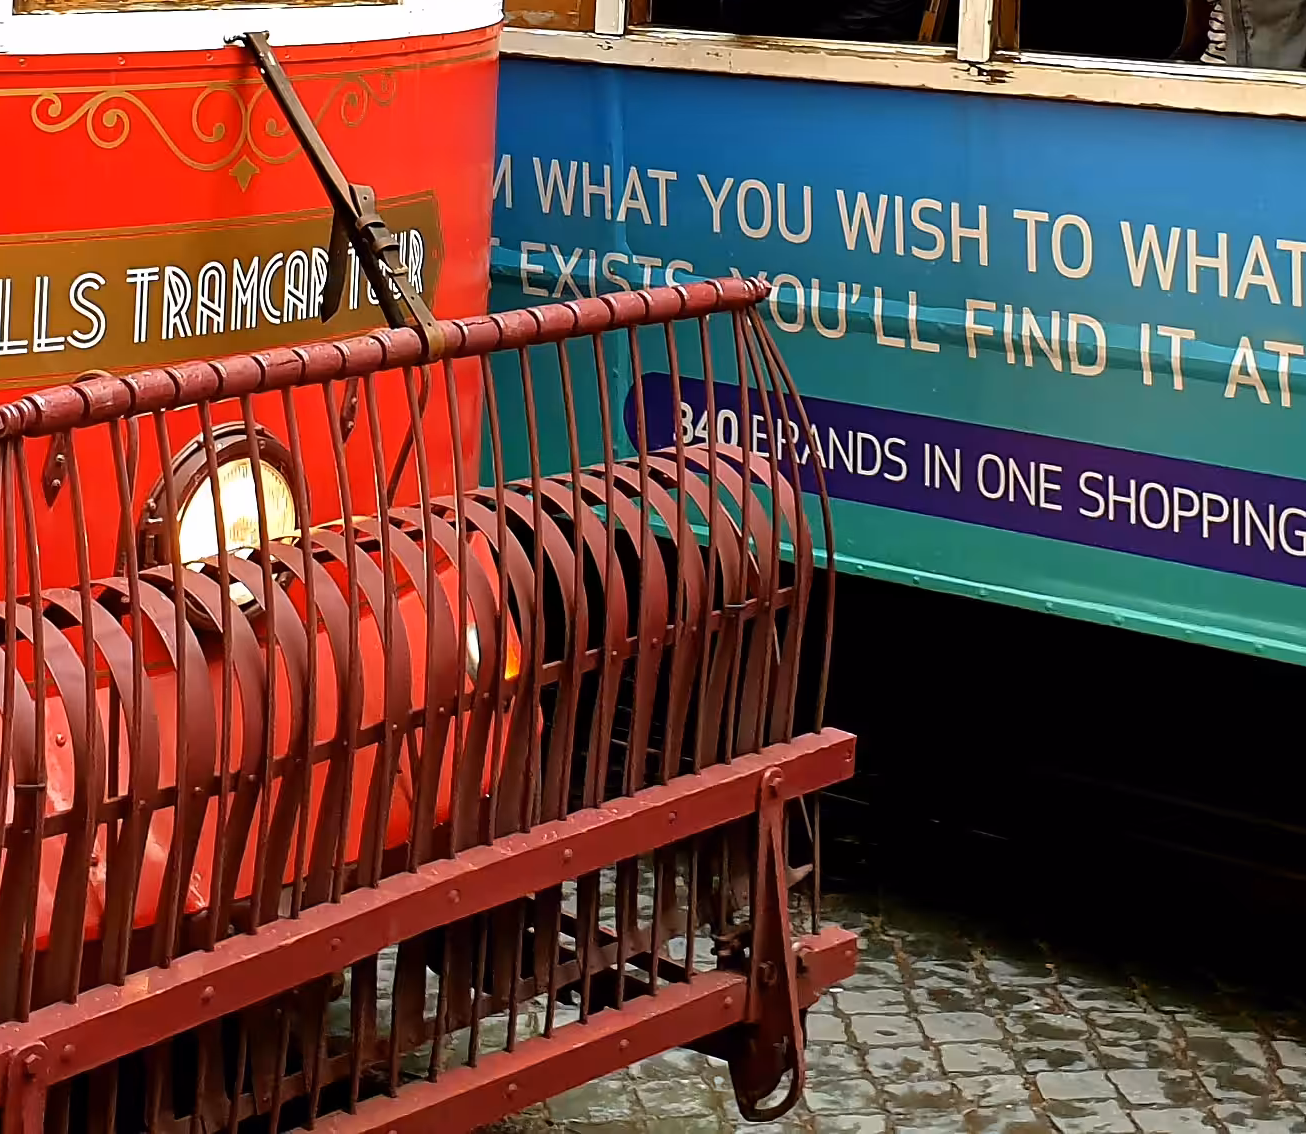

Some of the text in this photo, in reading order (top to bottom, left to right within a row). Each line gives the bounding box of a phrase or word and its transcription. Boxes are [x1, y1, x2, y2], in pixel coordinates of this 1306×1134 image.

[532, 156, 678, 227] WHAT
[696, 173, 813, 245] YOU
[836, 188, 989, 267] WISH
[1013, 208, 1093, 279] TO
[125, 246, 331, 344] TRAMCAR
[964, 298, 1108, 377] FIND
[1139, 322, 1196, 391] IT
[1224, 335, 1305, 408] AT
[924, 442, 961, 494] IN
[977, 453, 1064, 512] ONE
